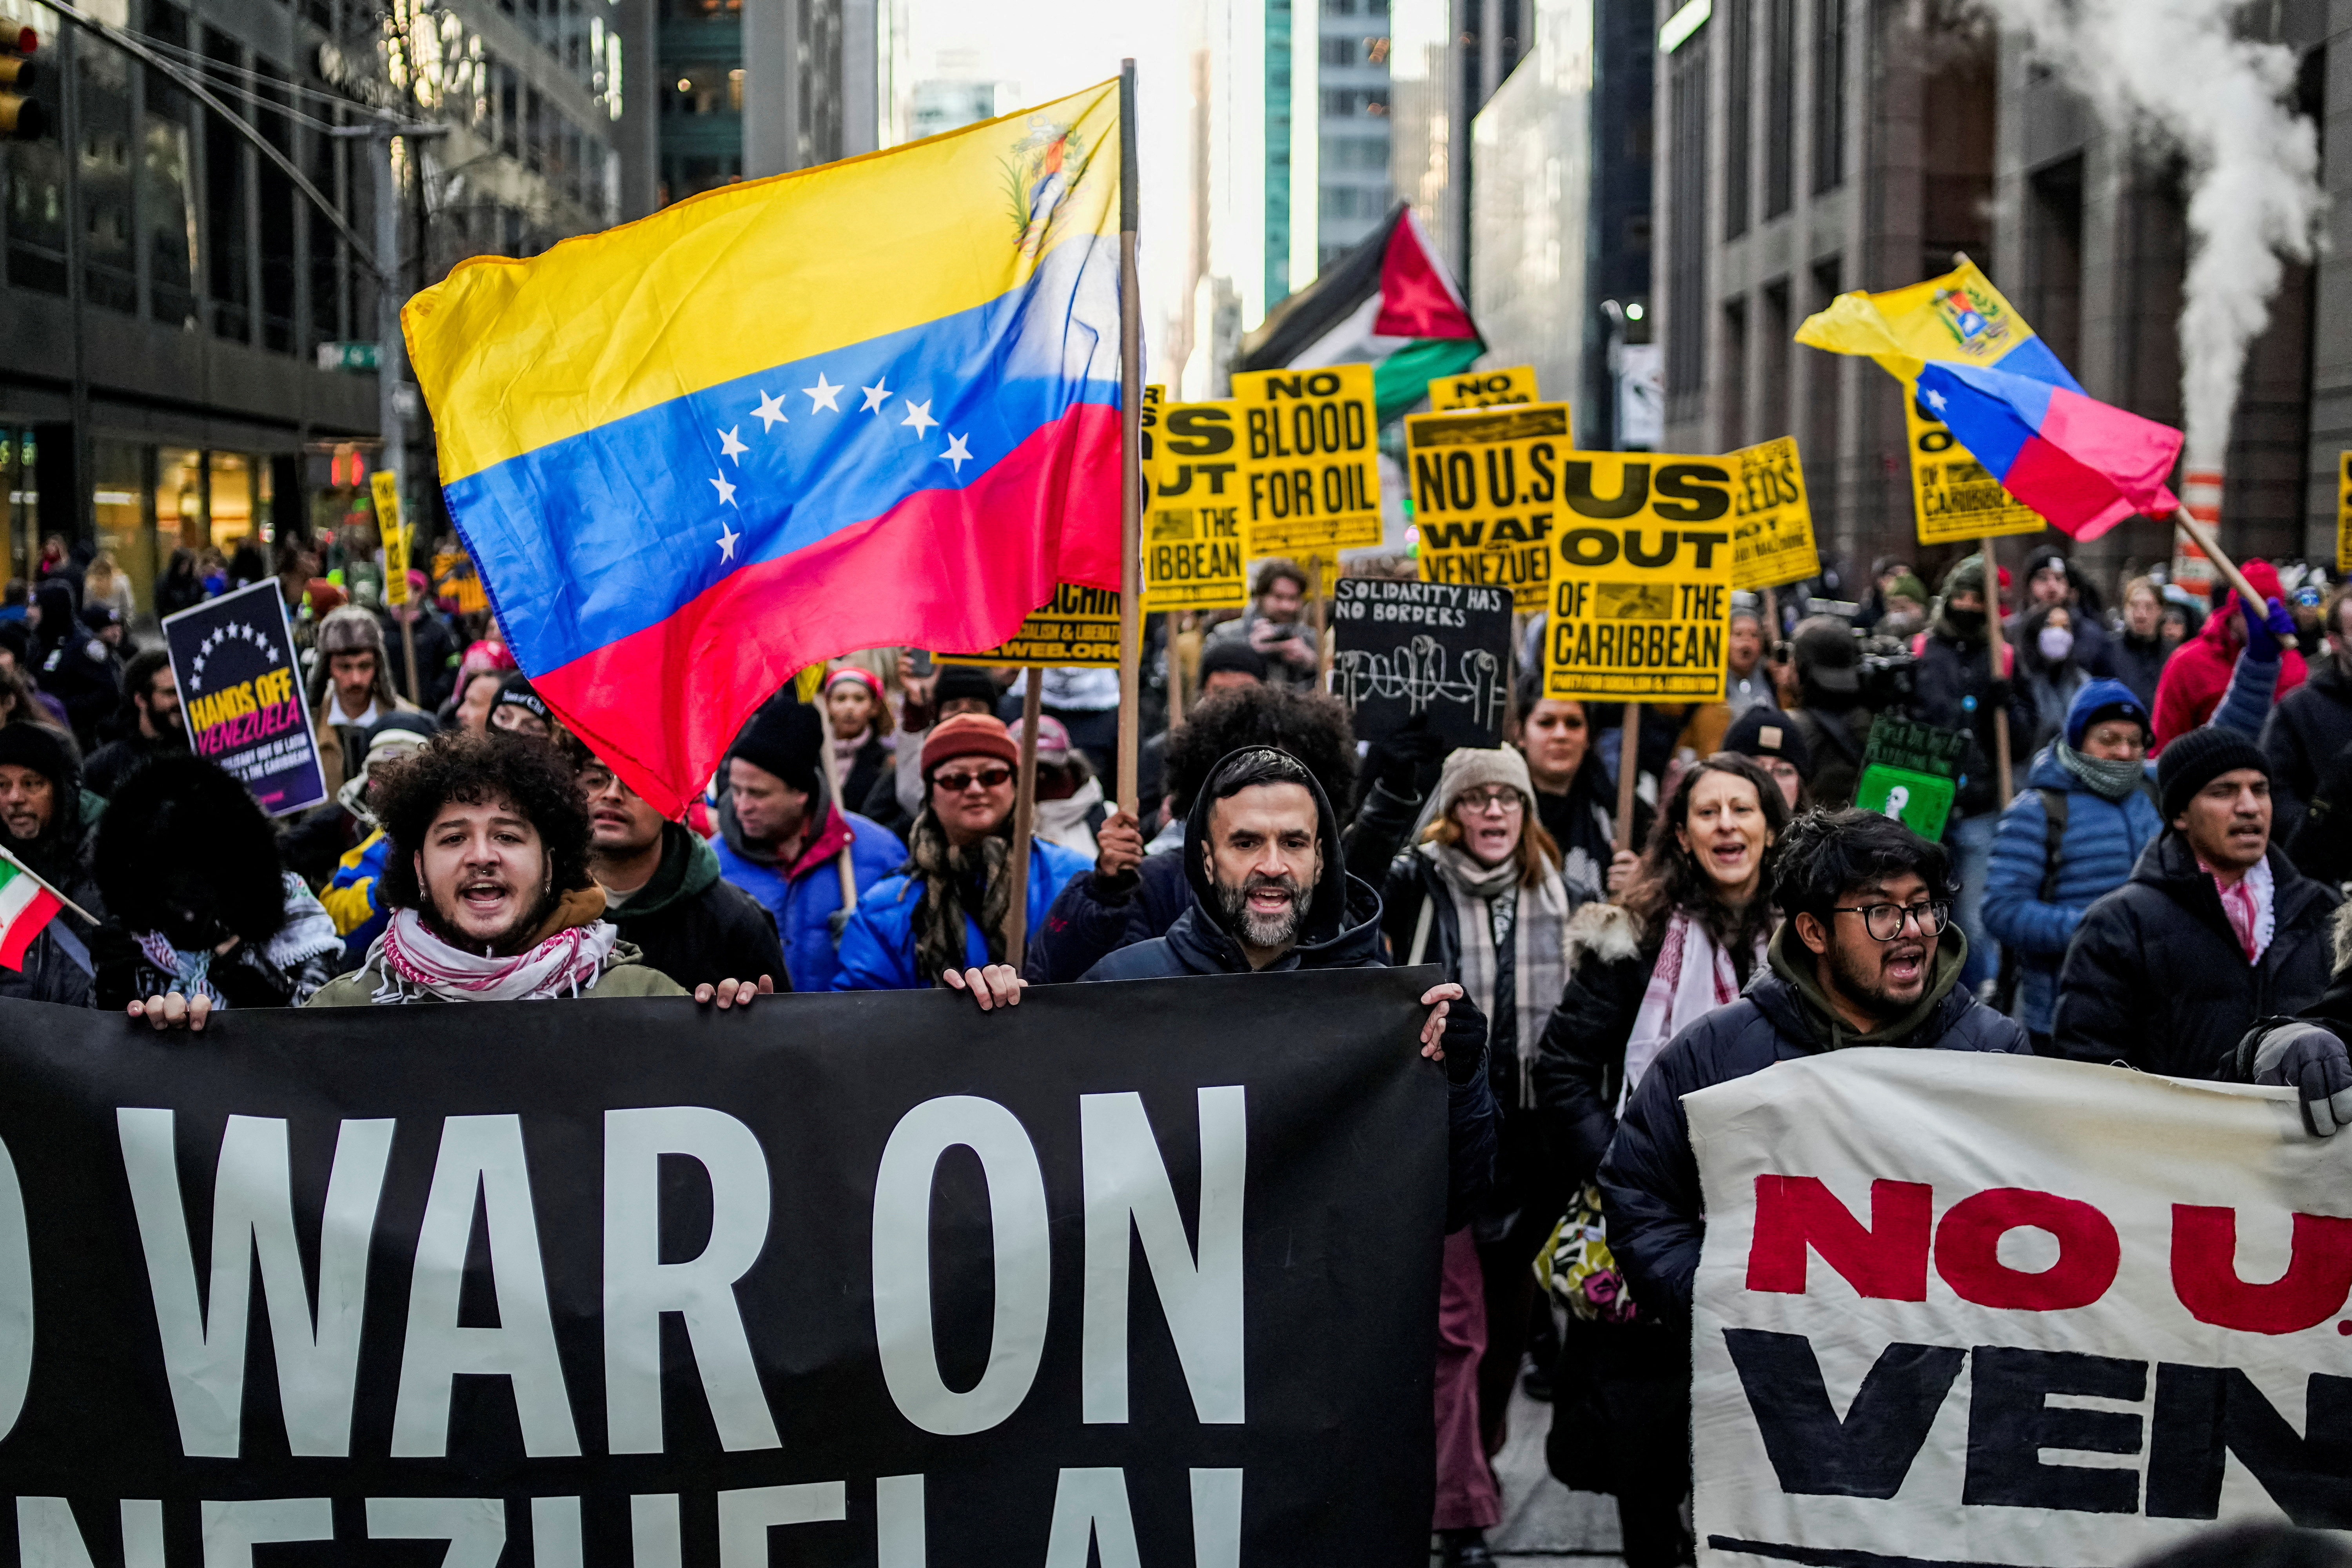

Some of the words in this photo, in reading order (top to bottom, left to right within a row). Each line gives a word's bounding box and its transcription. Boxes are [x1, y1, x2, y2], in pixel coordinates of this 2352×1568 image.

[1267, 372, 1340, 400] NO
[1455, 375, 1511, 398] NO
[1166, 408, 1234, 455] S
[1248, 401, 1366, 459] BLOOD
[1158, 463, 1237, 497] UT
[1250, 468, 1314, 521] FOR
[1324, 463, 1375, 514] OIL
[1416, 450, 1475, 513] NO
[1564, 461, 1730, 522] US
[1200, 507, 1239, 538] THE
[1150, 542, 1241, 582] IBBEAN
[1559, 527, 1728, 569] OUT
[1334, 601, 1366, 620] NO
[1373, 603, 1466, 628] BORDERS
[1336, 580, 1462, 608] SOLIDARITY
[1466, 587, 1502, 613] HAS
[1557, 581, 1588, 618] OF
[1680, 584, 1723, 621] THE
[1553, 623, 1720, 668] CARIBBEAN
[189, 681, 258, 733] HANDS
[255, 666, 292, 709] OFF
[197, 694, 300, 756] VENEZUELA
[1745, 1174, 2120, 1312] NO
[116, 1106, 782, 1458] WAR
[872, 1085, 1246, 1436] ON
[1721, 1327, 2352, 1532] VEN
